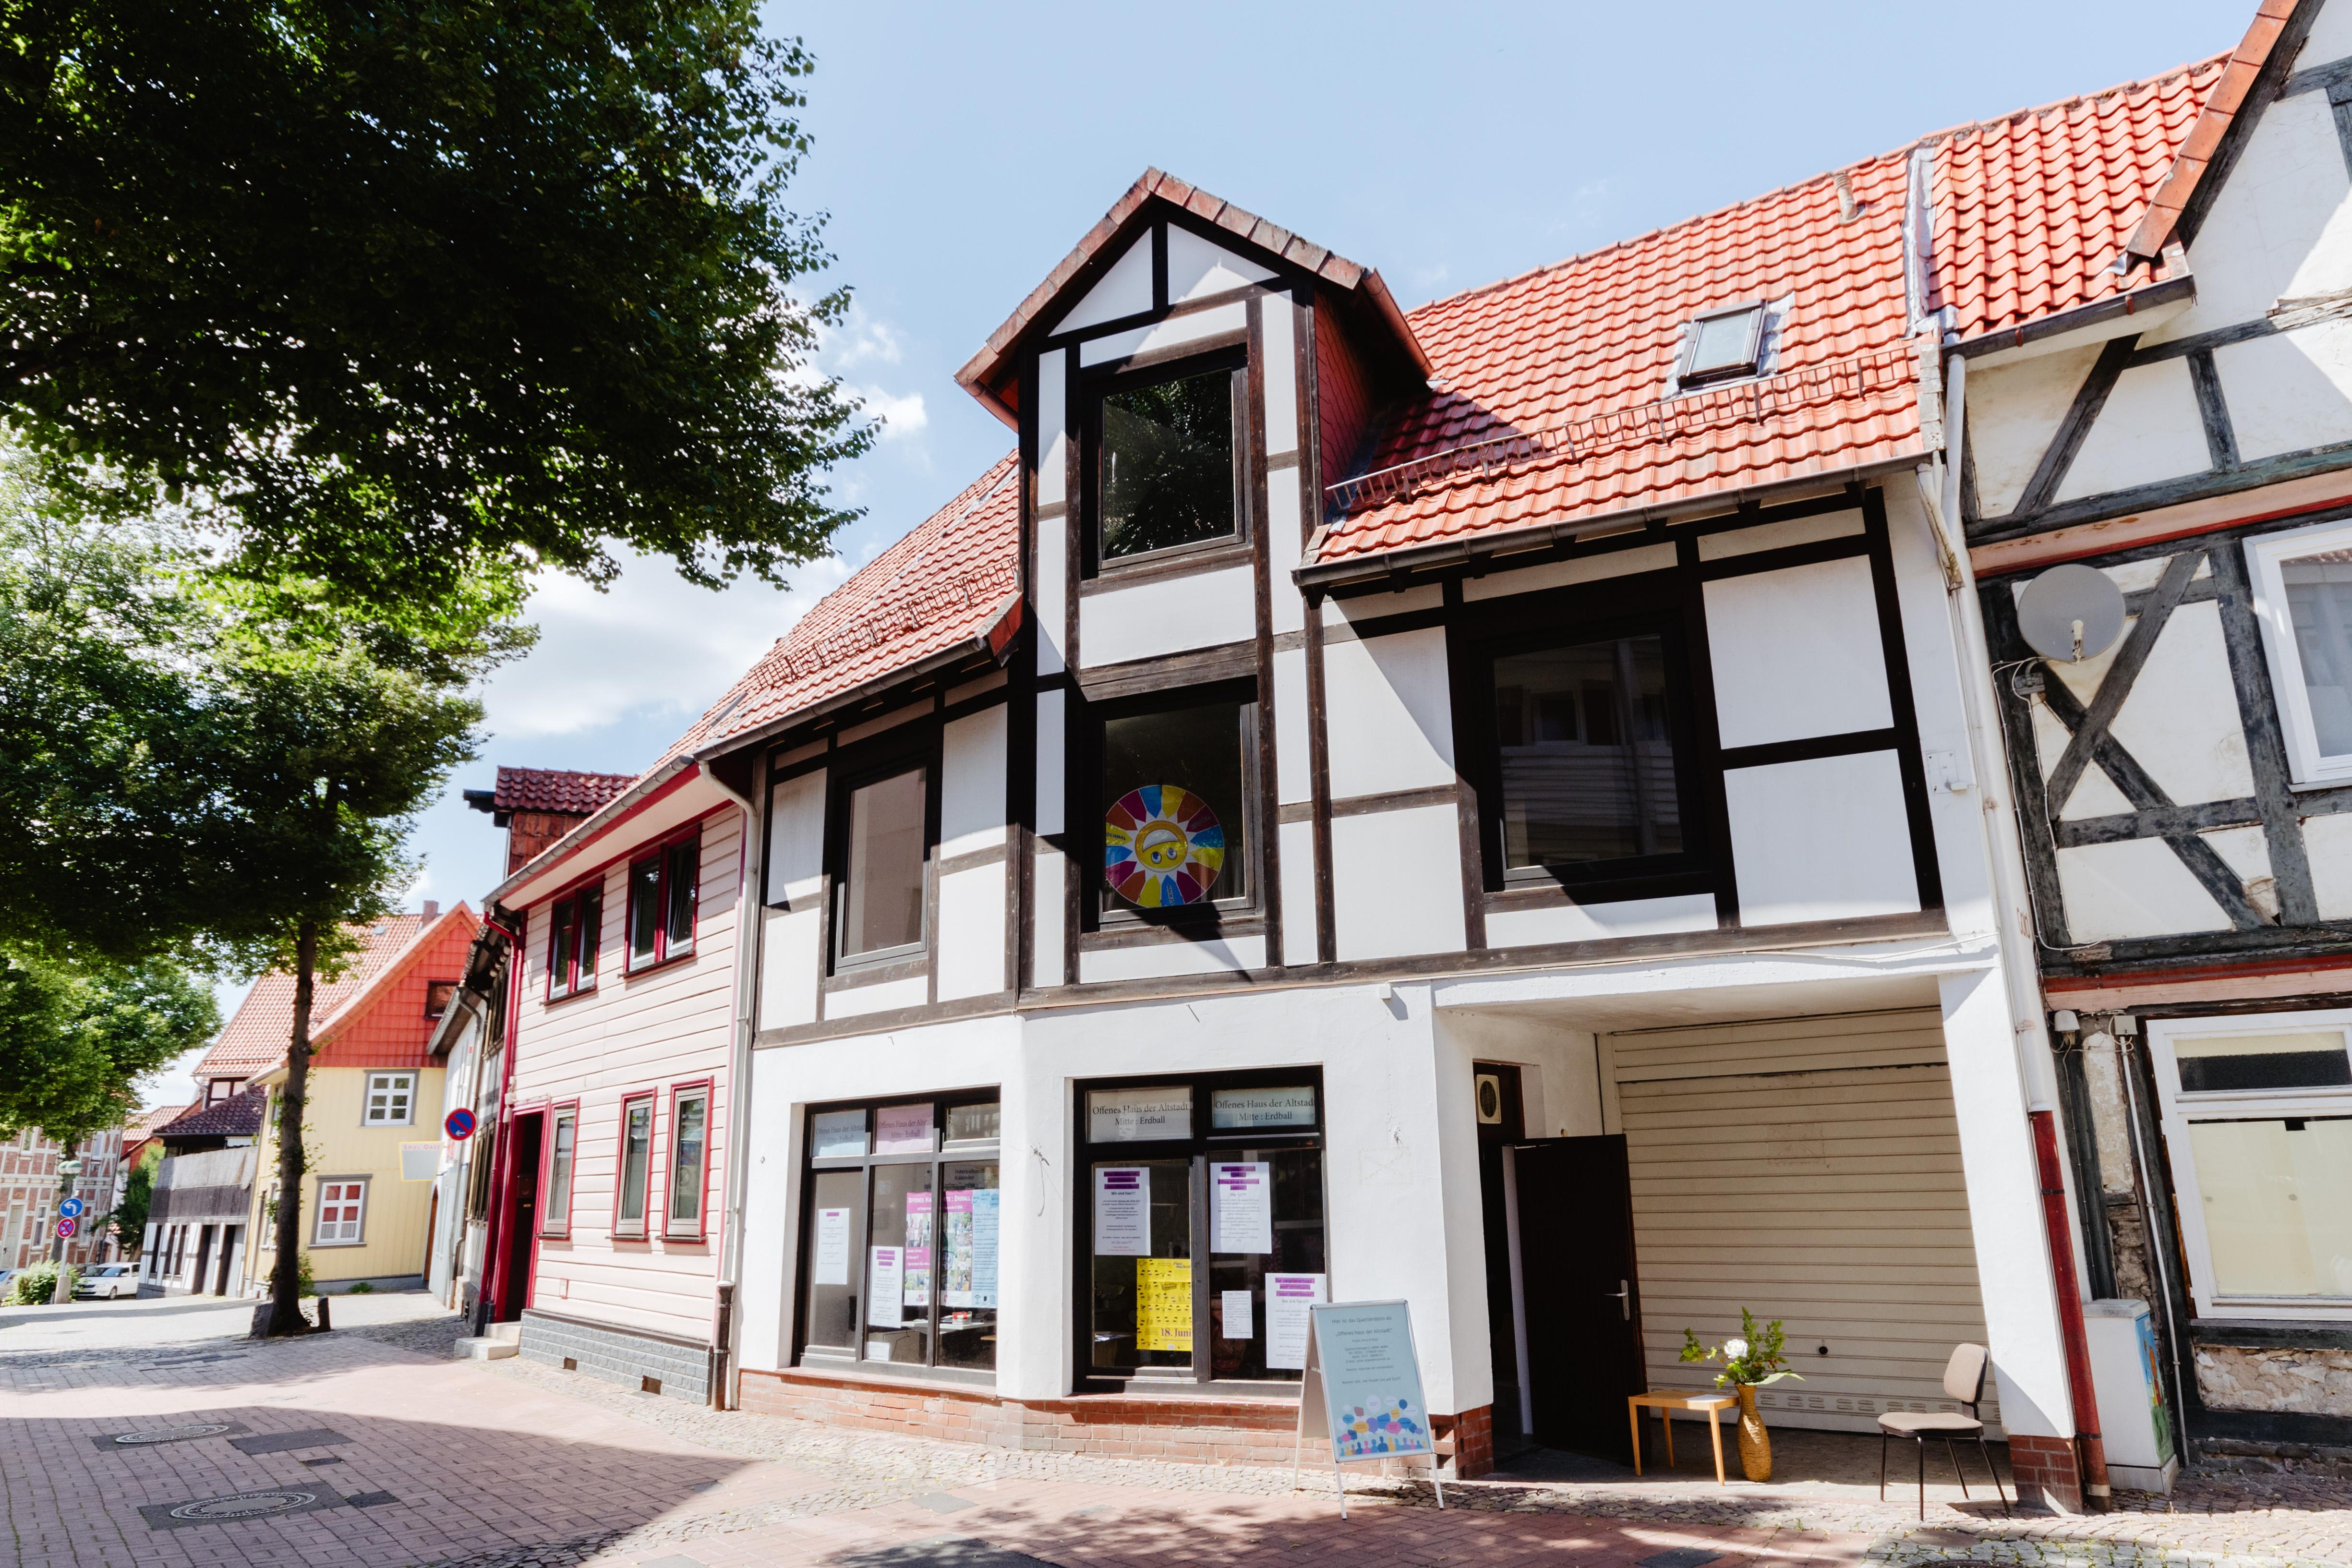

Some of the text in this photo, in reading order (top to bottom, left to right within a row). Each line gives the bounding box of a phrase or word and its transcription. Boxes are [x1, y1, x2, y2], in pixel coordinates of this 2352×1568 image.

[1106, 832, 1126, 840] OCHMAL
[1093, 1106, 1121, 1114] Offenes
[1144, 1104, 1156, 1112] der
[1158, 1102, 1188, 1111] Altstadt
[1216, 1098, 1314, 1109] Offenes Haus der Altstad
[1140, 1116, 1165, 1124] Erdball
[1265, 1111, 1292, 1120] Erdball
[1161, 1328, 1192, 1337] 18. Juni
